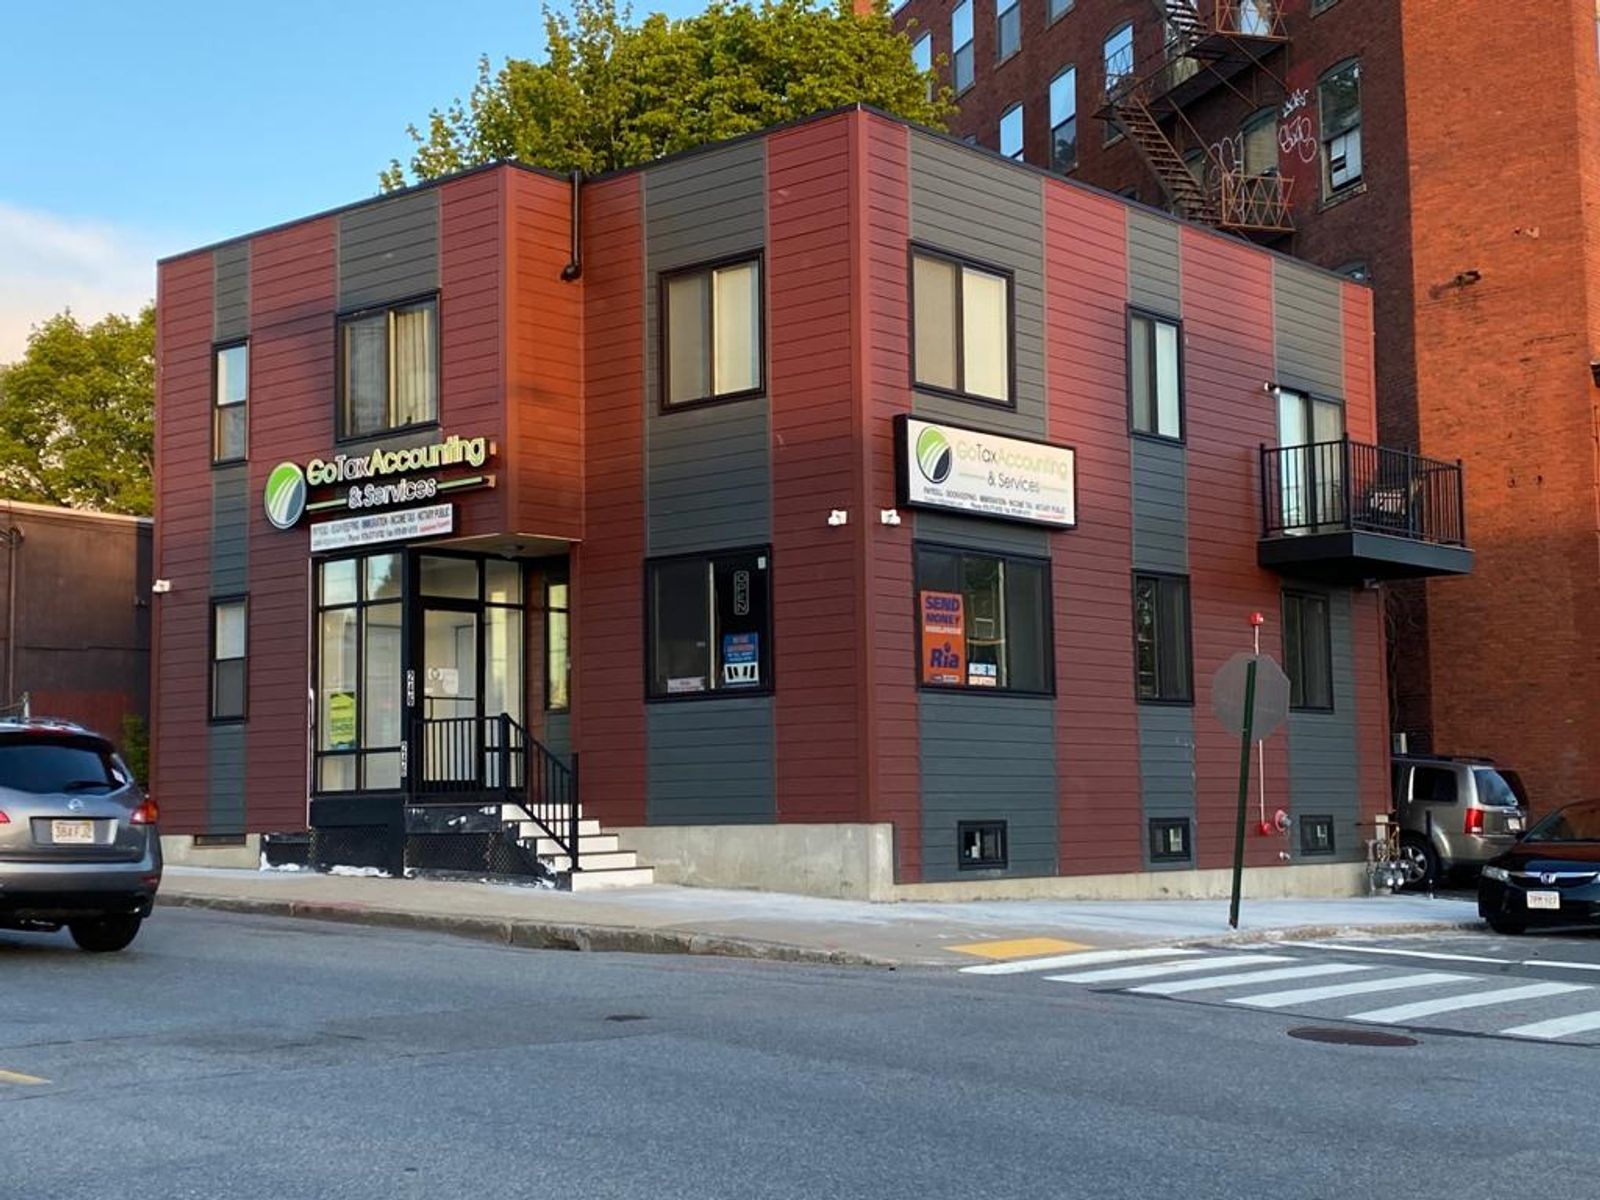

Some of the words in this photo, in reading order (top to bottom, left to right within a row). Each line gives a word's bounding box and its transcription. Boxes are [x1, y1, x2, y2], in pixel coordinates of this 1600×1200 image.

[306, 435, 485, 485] GoTaxAccounting
[348, 486, 363, 508] &
[364, 478, 437, 508] Services
[987, 471, 996, 487] &
[998, 472, 1040, 493] Services
[925, 595, 960, 612] SEND
[930, 643, 959, 669] Ria
